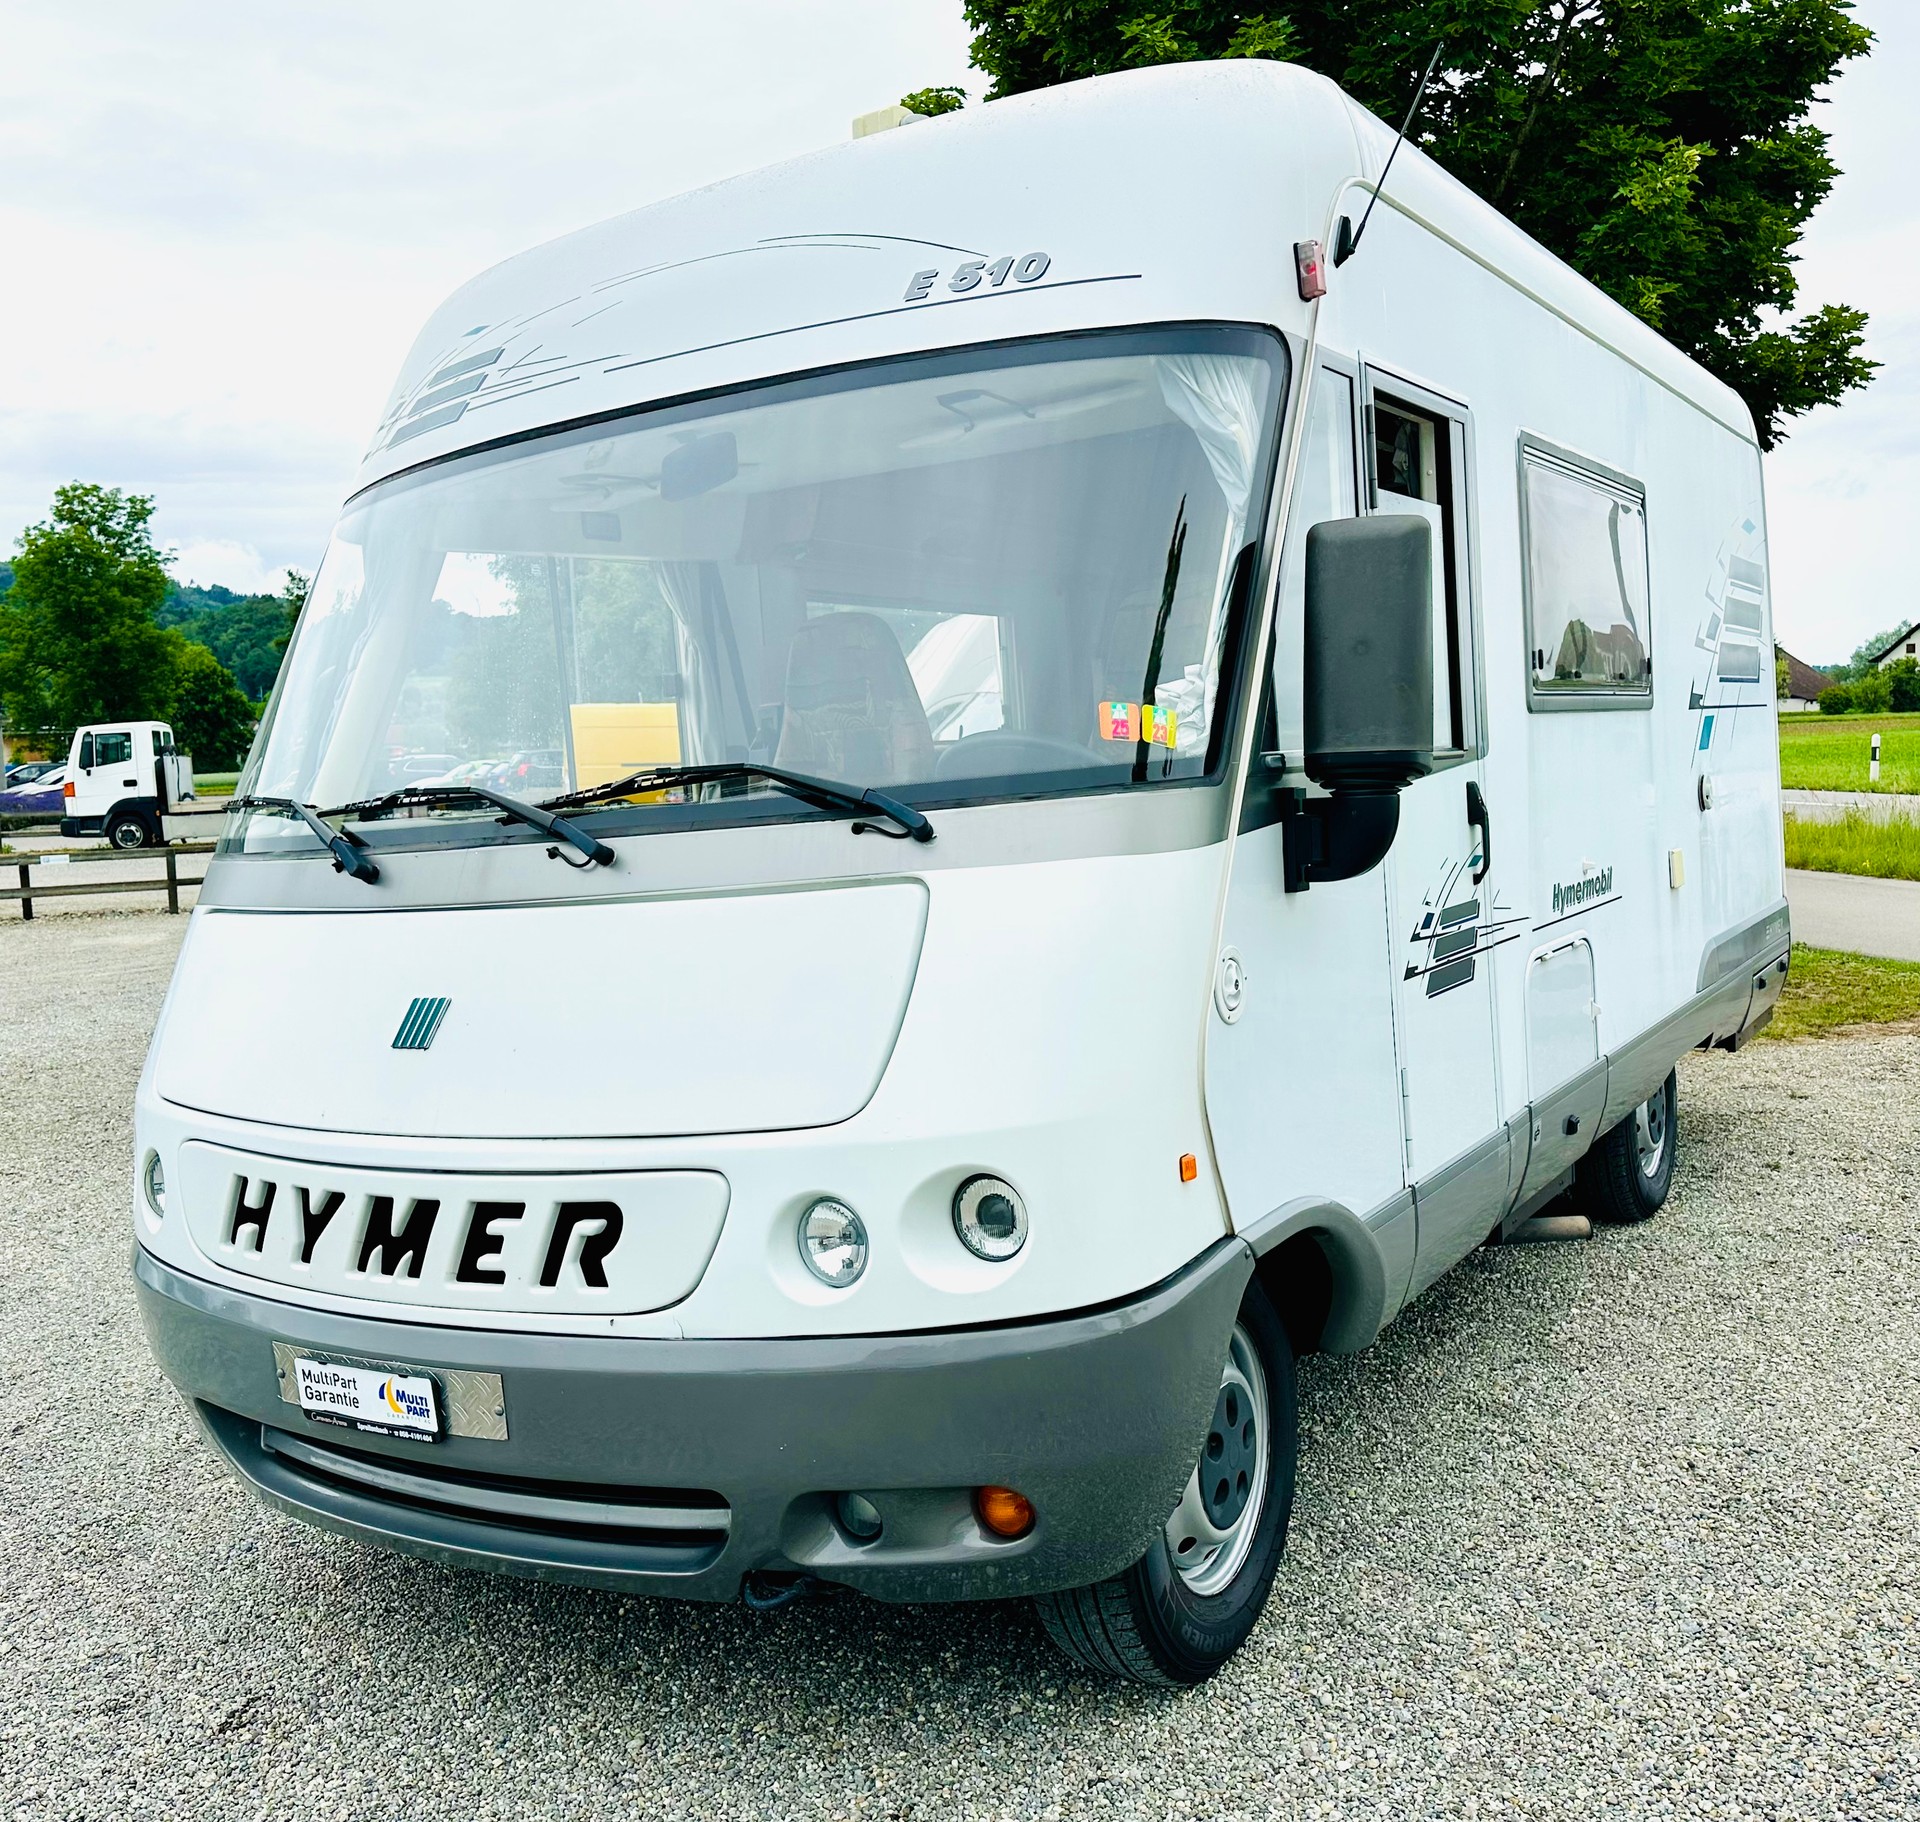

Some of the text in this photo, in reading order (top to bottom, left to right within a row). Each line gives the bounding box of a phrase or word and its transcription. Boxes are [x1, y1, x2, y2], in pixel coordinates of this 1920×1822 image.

[903, 251, 1051, 302] E 510
[1111, 719, 1130, 736] 25
[1152, 724, 1168, 742] 23
[1552, 865, 1613, 916] Hymermobil
[219, 1172, 625, 1294] HYMER
[301, 1368, 358, 1391] MultiPart
[304, 1386, 360, 1409] Garantie
[395, 1388, 428, 1407] MULTI
[406, 1404, 430, 1419] PART
